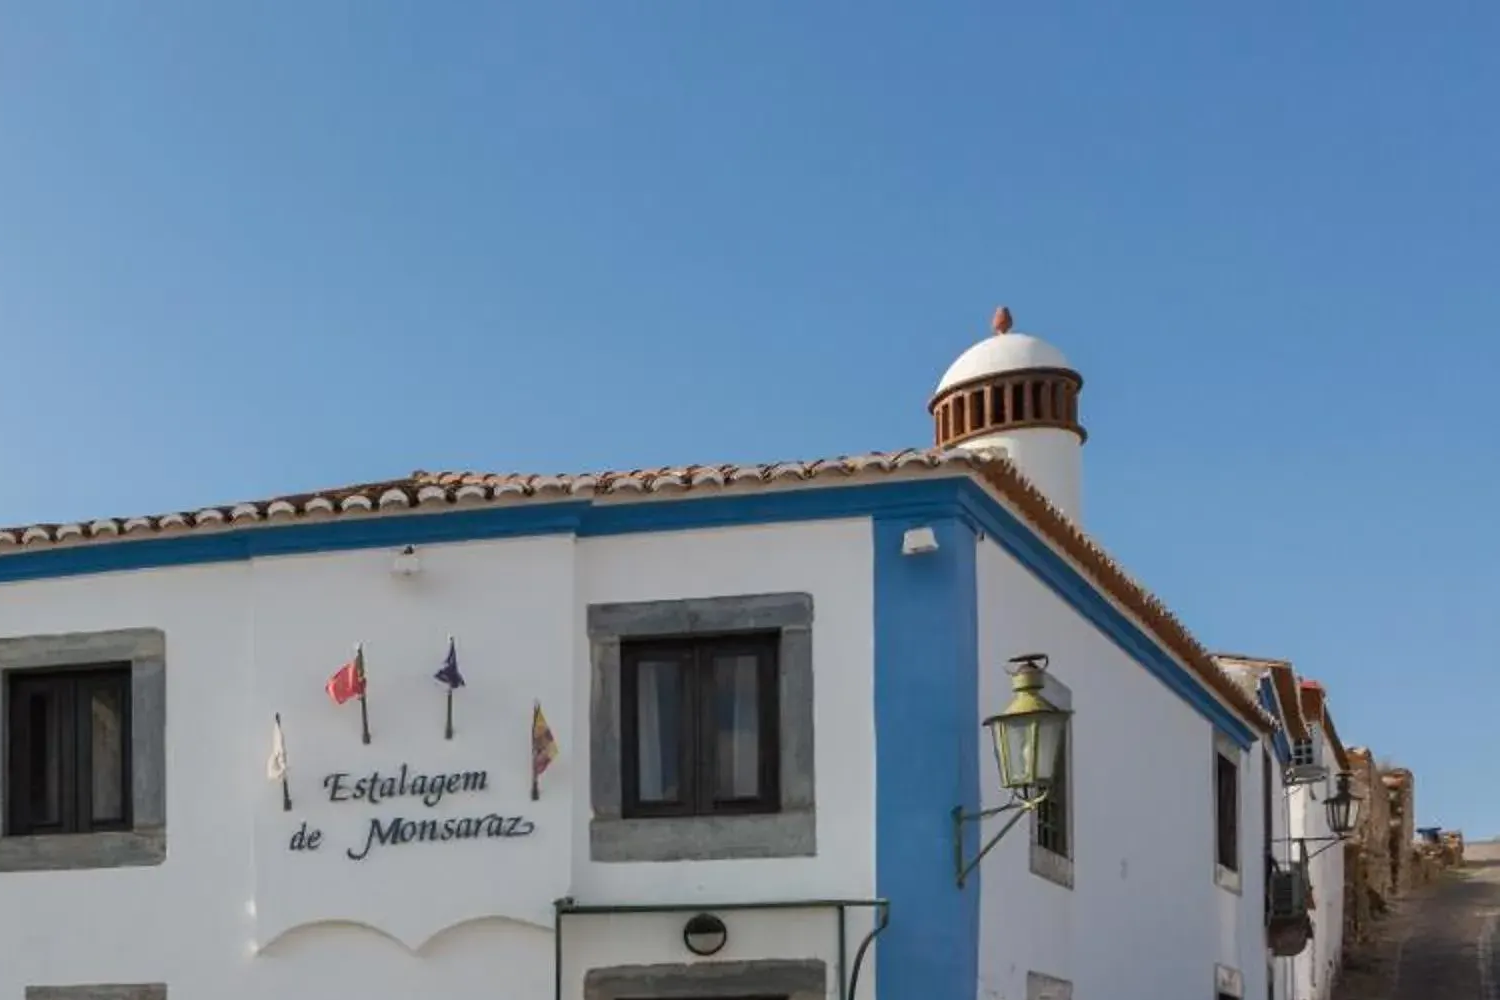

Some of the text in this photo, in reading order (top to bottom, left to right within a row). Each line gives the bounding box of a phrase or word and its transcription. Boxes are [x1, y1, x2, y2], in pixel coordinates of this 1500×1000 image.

[324, 763, 488, 806] Estalagem
[289, 812, 534, 860] de Monsaraz
